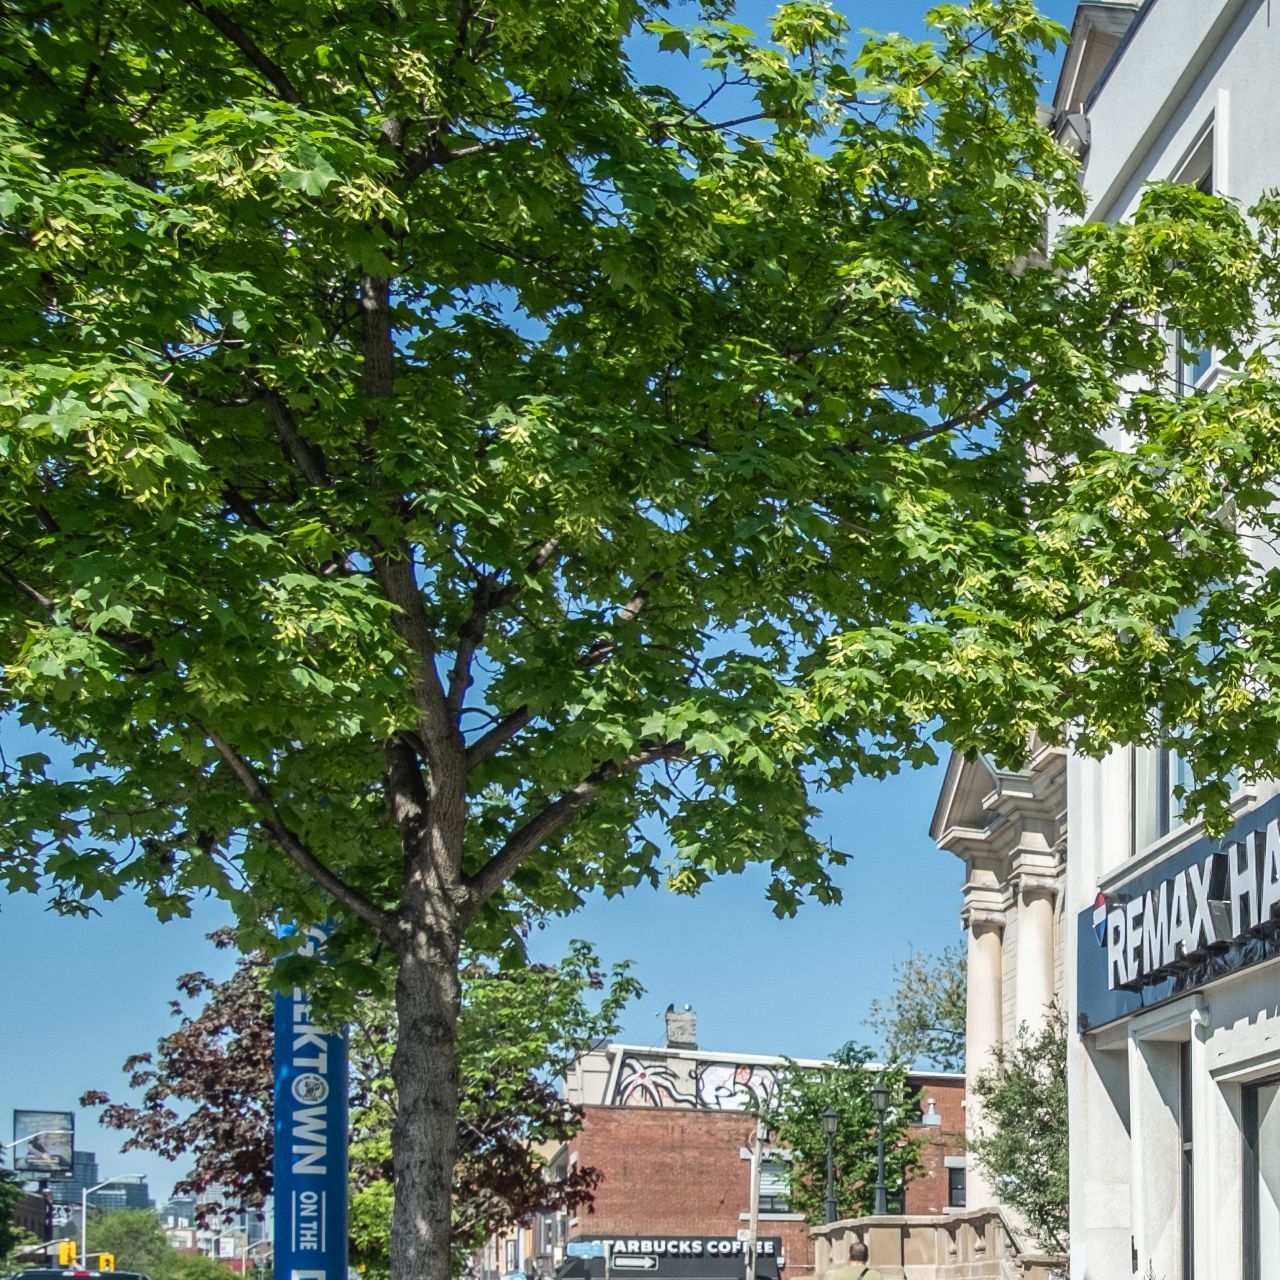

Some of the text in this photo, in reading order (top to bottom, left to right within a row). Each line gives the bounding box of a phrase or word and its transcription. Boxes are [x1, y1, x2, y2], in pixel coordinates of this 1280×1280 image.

[1107, 853, 1217, 990] REMAX
[300, 1191, 318, 1217] ON
[300, 1221, 318, 1250] THE
